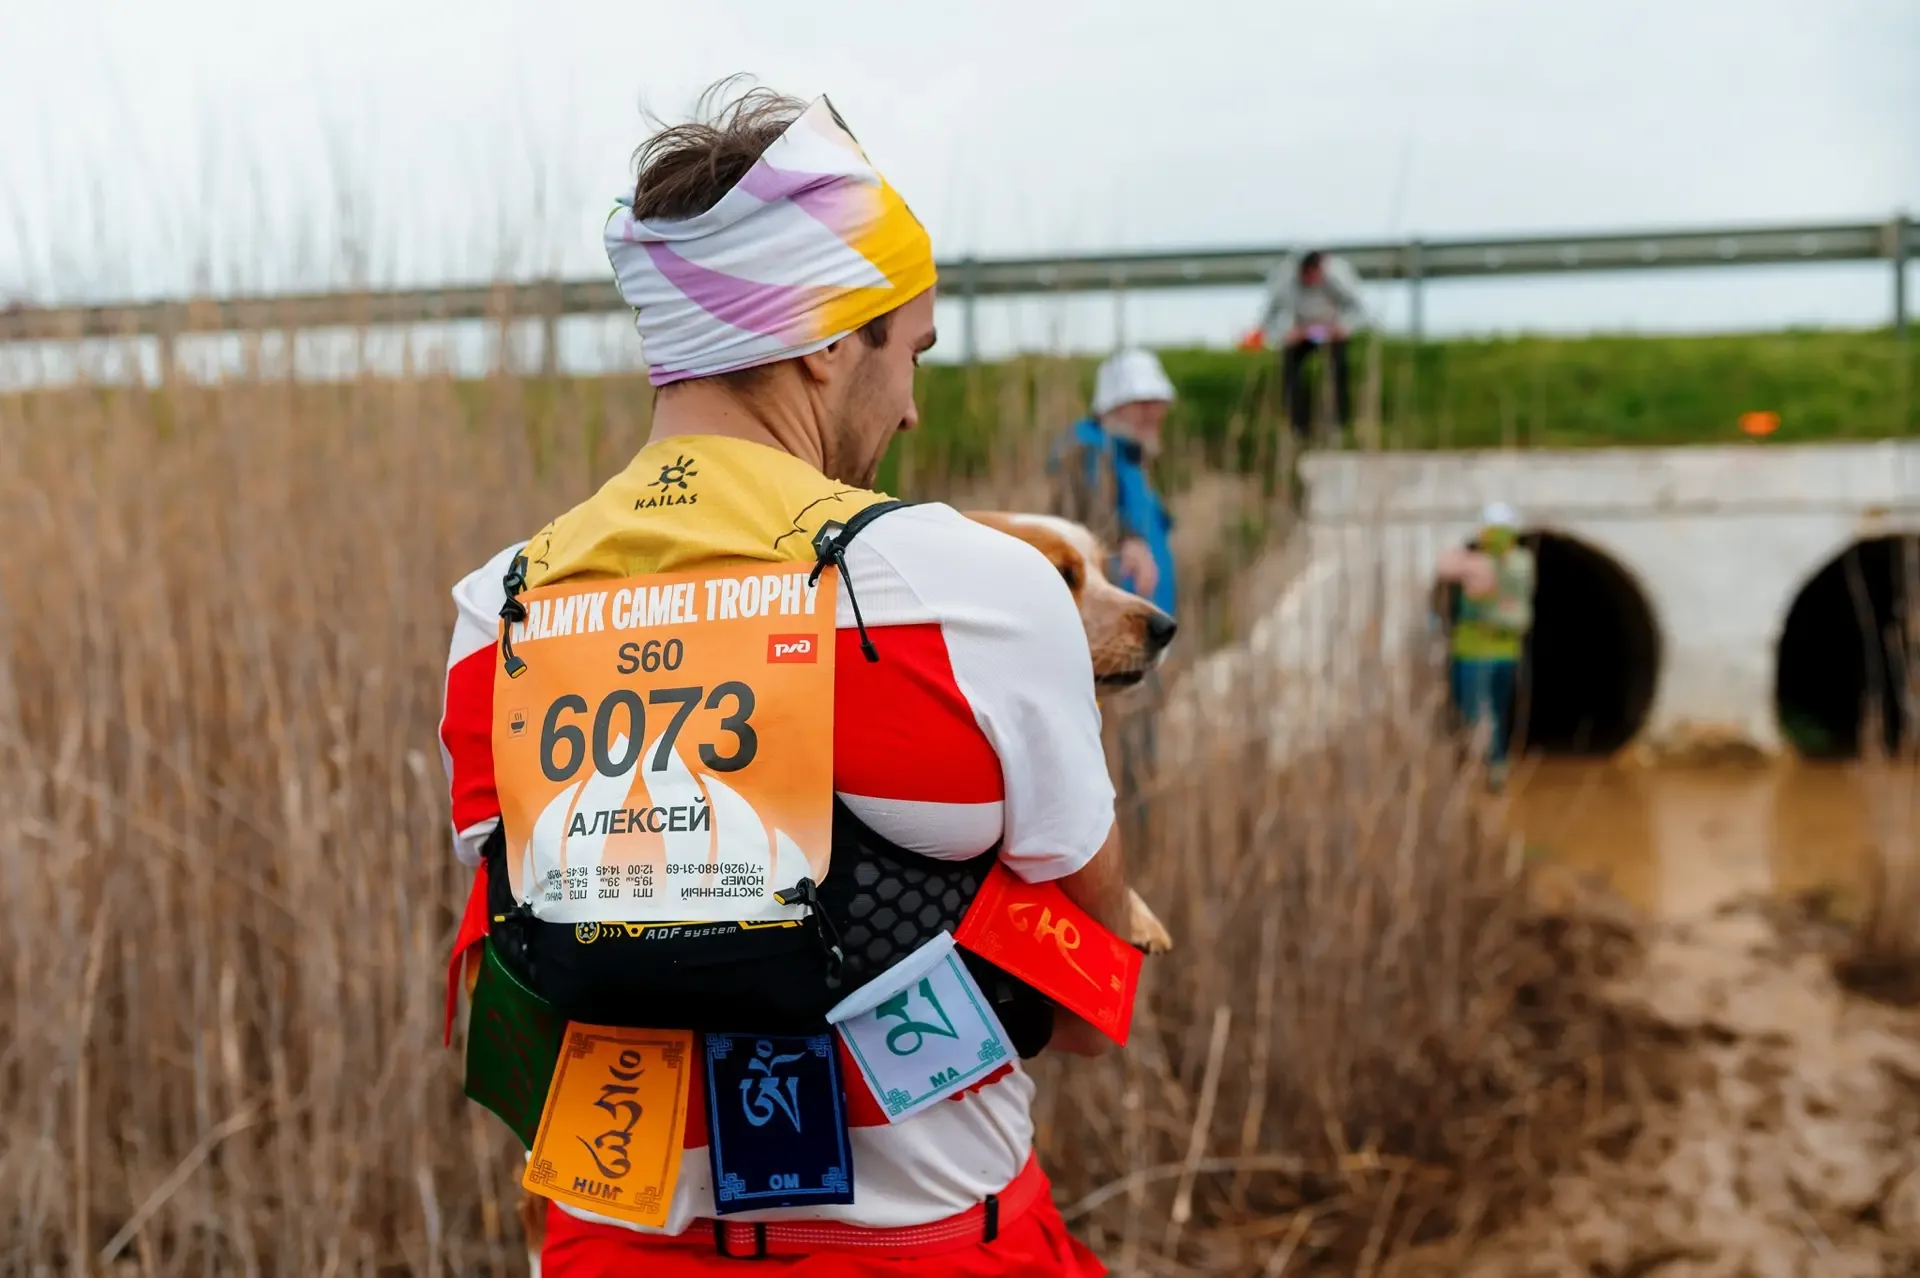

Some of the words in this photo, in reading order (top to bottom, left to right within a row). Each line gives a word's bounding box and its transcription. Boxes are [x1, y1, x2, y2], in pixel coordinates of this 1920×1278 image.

[634, 493, 698, 511] KAILAS
[612, 582, 699, 630] CAMEL
[704, 573, 820, 621] TROPHY
[616, 638, 684, 675] S60
[539, 681, 758, 782] 6073
[567, 796, 711, 838] АЛЕКСЕЙ
[566, 866, 588, 878] 16:45
[595, 865, 620, 876] 14:45
[627, 864, 654, 875] 12:00
[666, 862, 764, 875] +7(926)680-31-69
[721, 875, 764, 886] НОМЕР
[569, 889, 587, 900] ПП3
[598, 889, 620, 899] ПП2
[633, 888, 653, 898] ПП1
[681, 887, 764, 901] ЭКСТРЕННЫЙ
[683, 925, 738, 938] system
[929, 1066, 960, 1088] MA
[769, 1173, 800, 1190] OM
[572, 1176, 624, 1201] HUM
